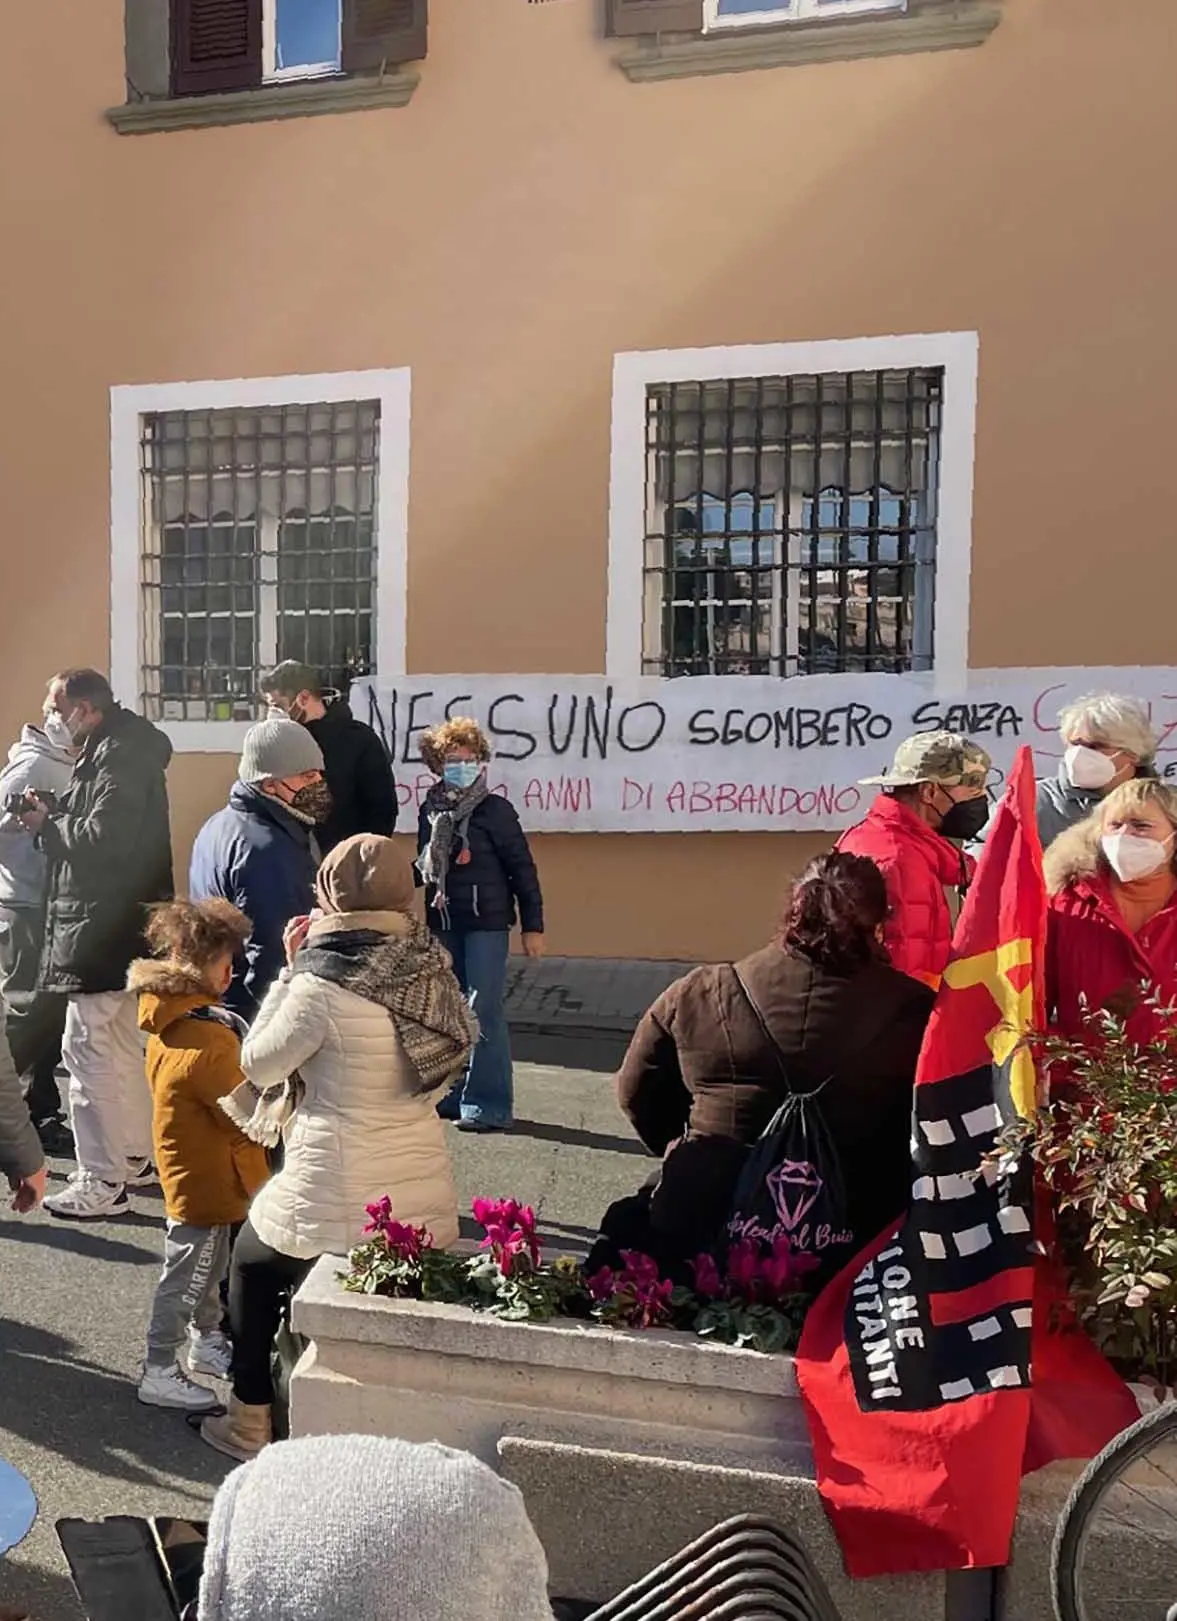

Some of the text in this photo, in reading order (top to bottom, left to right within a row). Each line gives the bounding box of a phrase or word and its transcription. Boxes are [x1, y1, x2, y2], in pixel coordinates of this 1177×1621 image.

[687, 702, 893, 750] SGOMBERO
[911, 701, 1024, 738] SENZA
[523, 774, 593, 813] ANNI
[621, 776, 654, 814] DI
[665, 780, 861, 816] ABBANDONO
